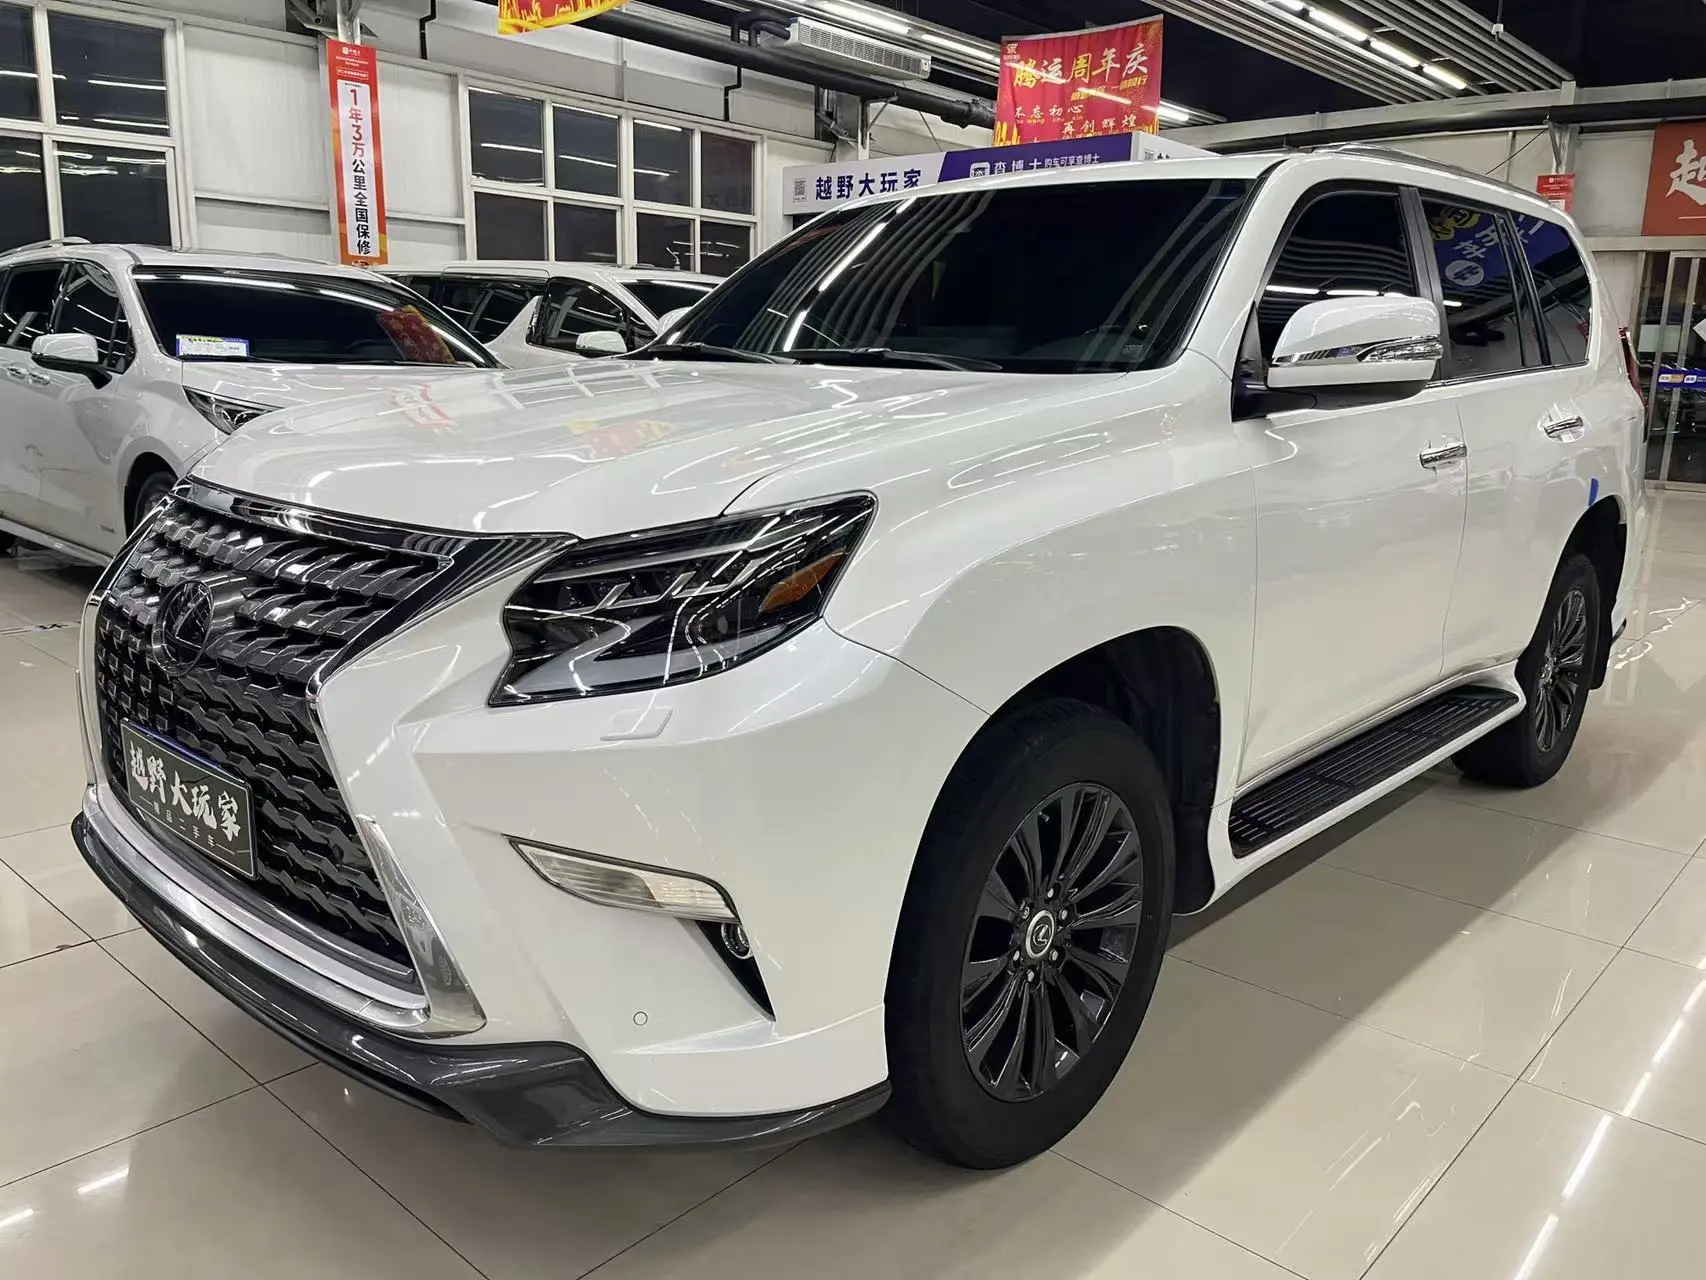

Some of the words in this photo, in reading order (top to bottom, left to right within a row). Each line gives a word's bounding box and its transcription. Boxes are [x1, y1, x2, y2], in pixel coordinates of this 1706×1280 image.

[348, 89, 371, 255] 1年3万公里全国保修
[815, 168, 921, 200] 越野大玩家
[130, 740, 241, 842] 越野大玩家
